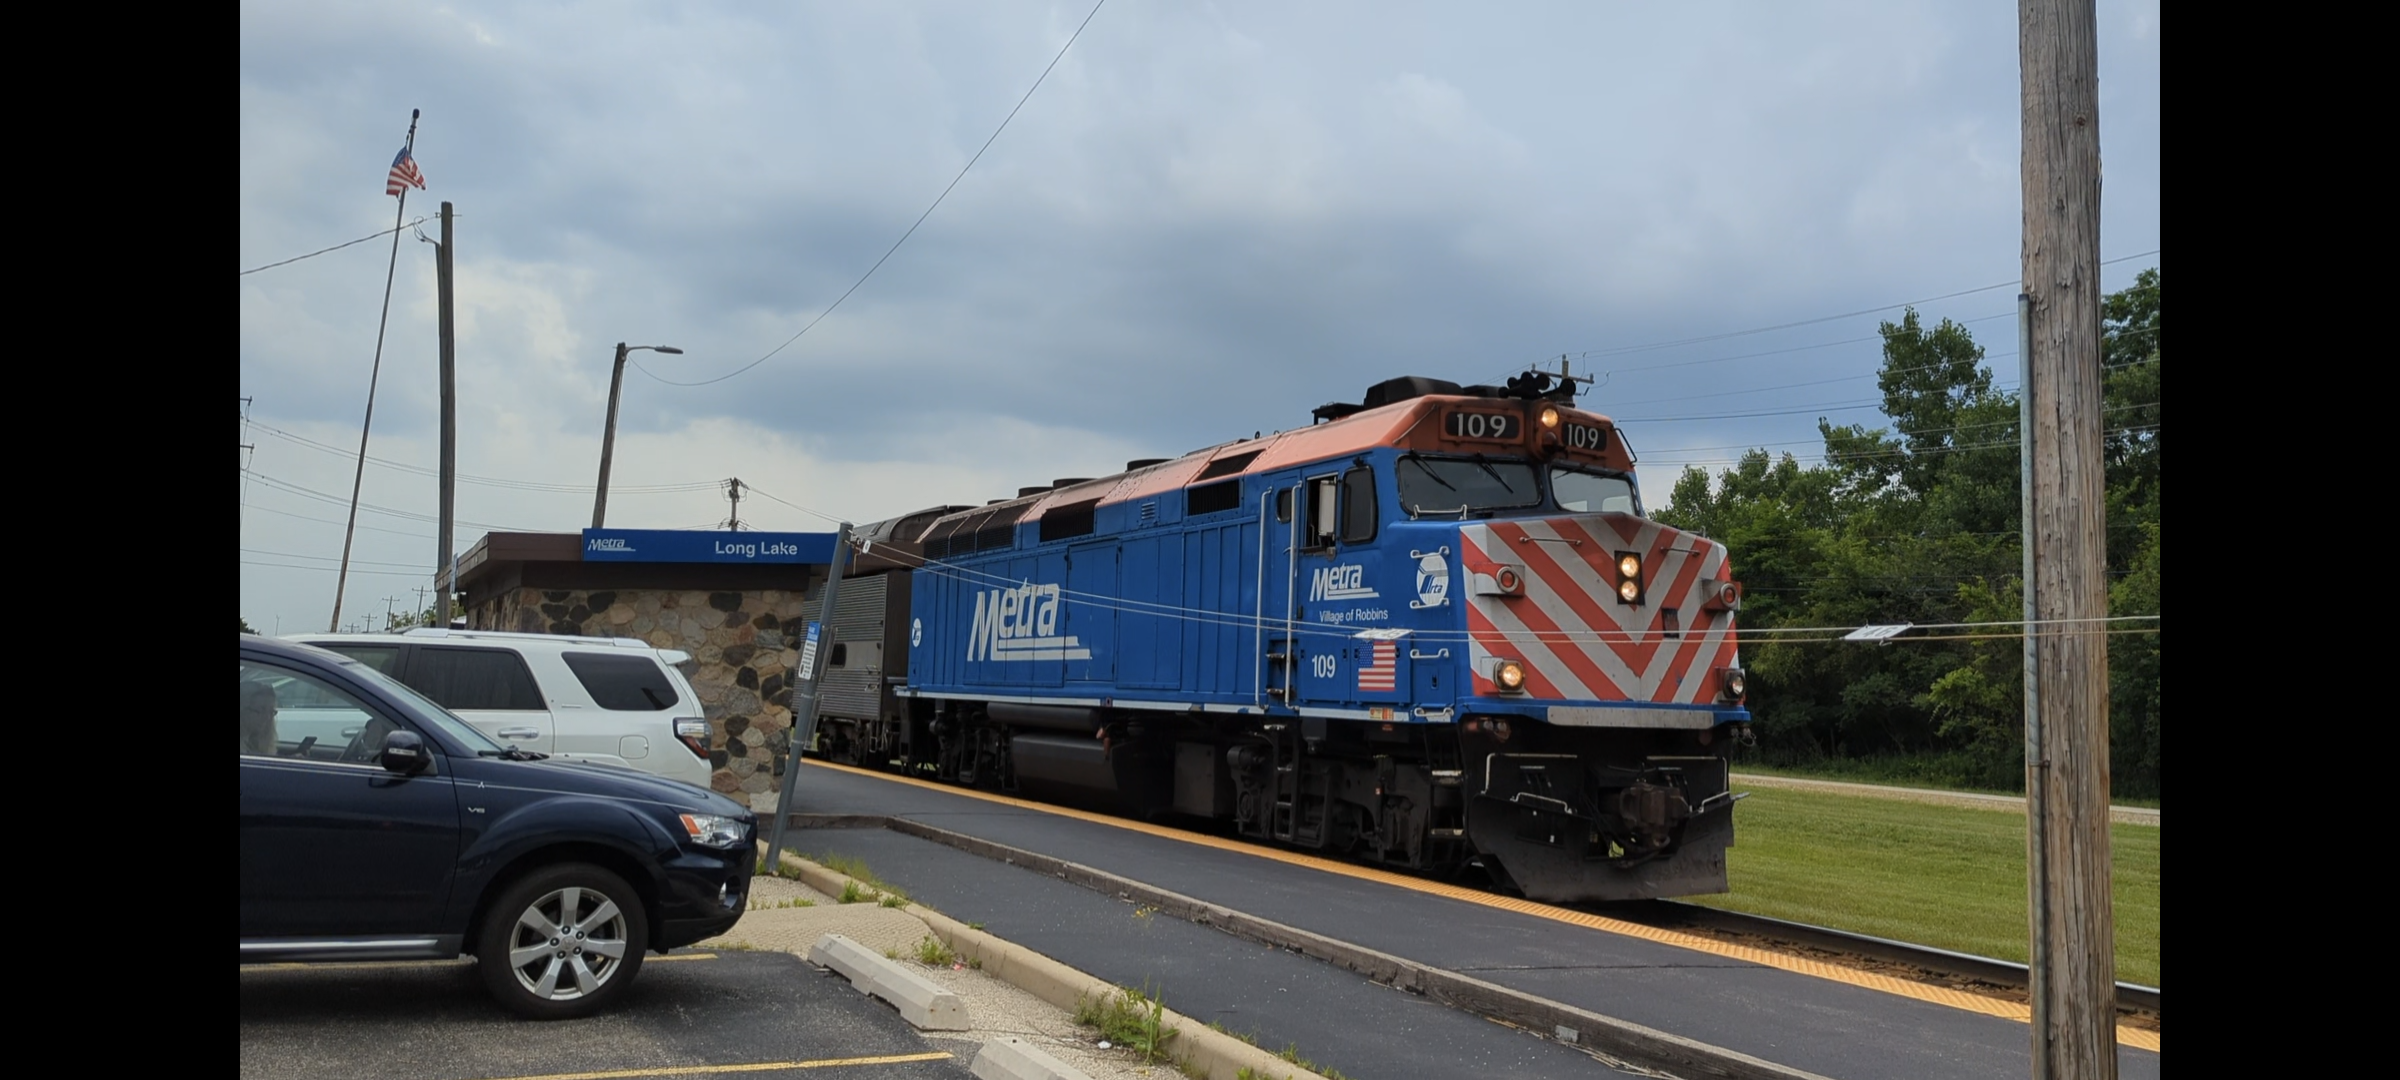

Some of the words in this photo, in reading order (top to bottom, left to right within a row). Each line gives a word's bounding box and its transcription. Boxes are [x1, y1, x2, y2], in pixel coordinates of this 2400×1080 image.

[1456, 413, 1506, 438] 109
[1568, 423, 1599, 449] 109
[587, 538, 625, 551] Metra
[715, 541, 756, 558] Long
[761, 541, 798, 555] Lake
[1309, 562, 1363, 602] Metra
[967, 577, 1061, 662] Metra
[1319, 610, 1343, 625] Village
[1346, 609, 1354, 621] of
[1355, 608, 1389, 621] Robbins
[1311, 654, 1336, 678] 109
